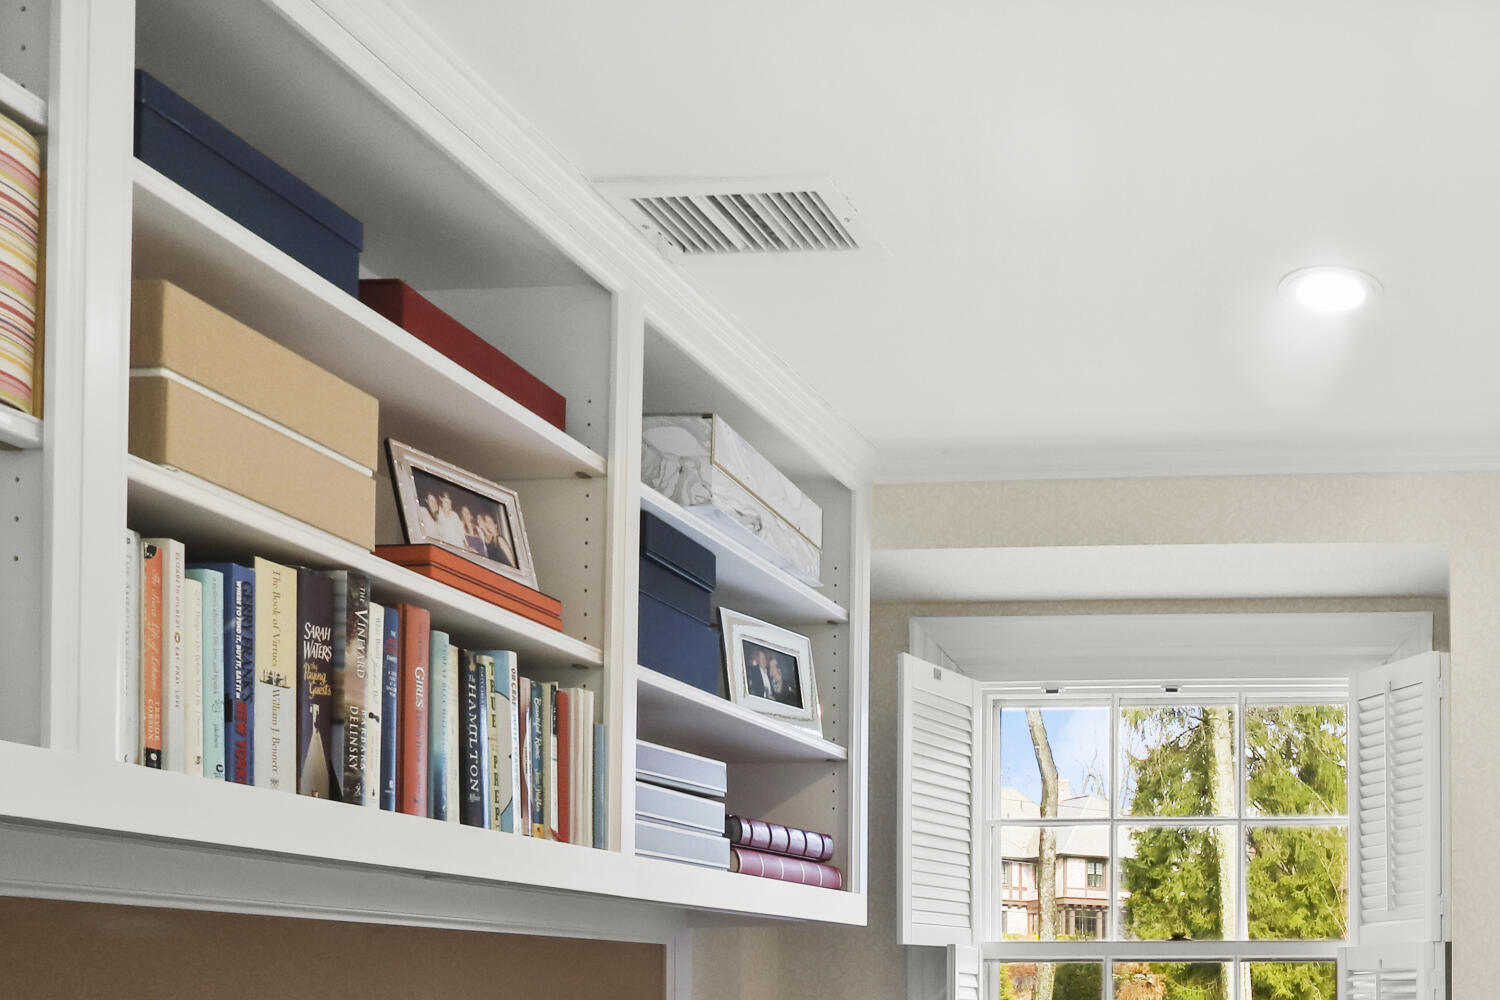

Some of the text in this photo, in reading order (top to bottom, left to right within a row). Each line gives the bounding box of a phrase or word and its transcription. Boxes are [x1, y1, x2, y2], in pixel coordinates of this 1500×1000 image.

[271, 570, 281, 667] The Book of Virtues
[304, 622, 331, 642] SARAH
[241, 581, 254, 703] GERRY FRANK'S
[304, 640, 332, 662] WATERS
[354, 610, 369, 680] VINEYARD
[304, 663, 327, 685] Paying
[309, 681, 331, 699] Guests
[235, 701, 248, 736] NEW
[271, 689, 281, 726] William
[271, 737, 281, 773] Bennett
[348, 705, 359, 771] DELINSKY
[468, 681, 479, 793] HAMILTON
